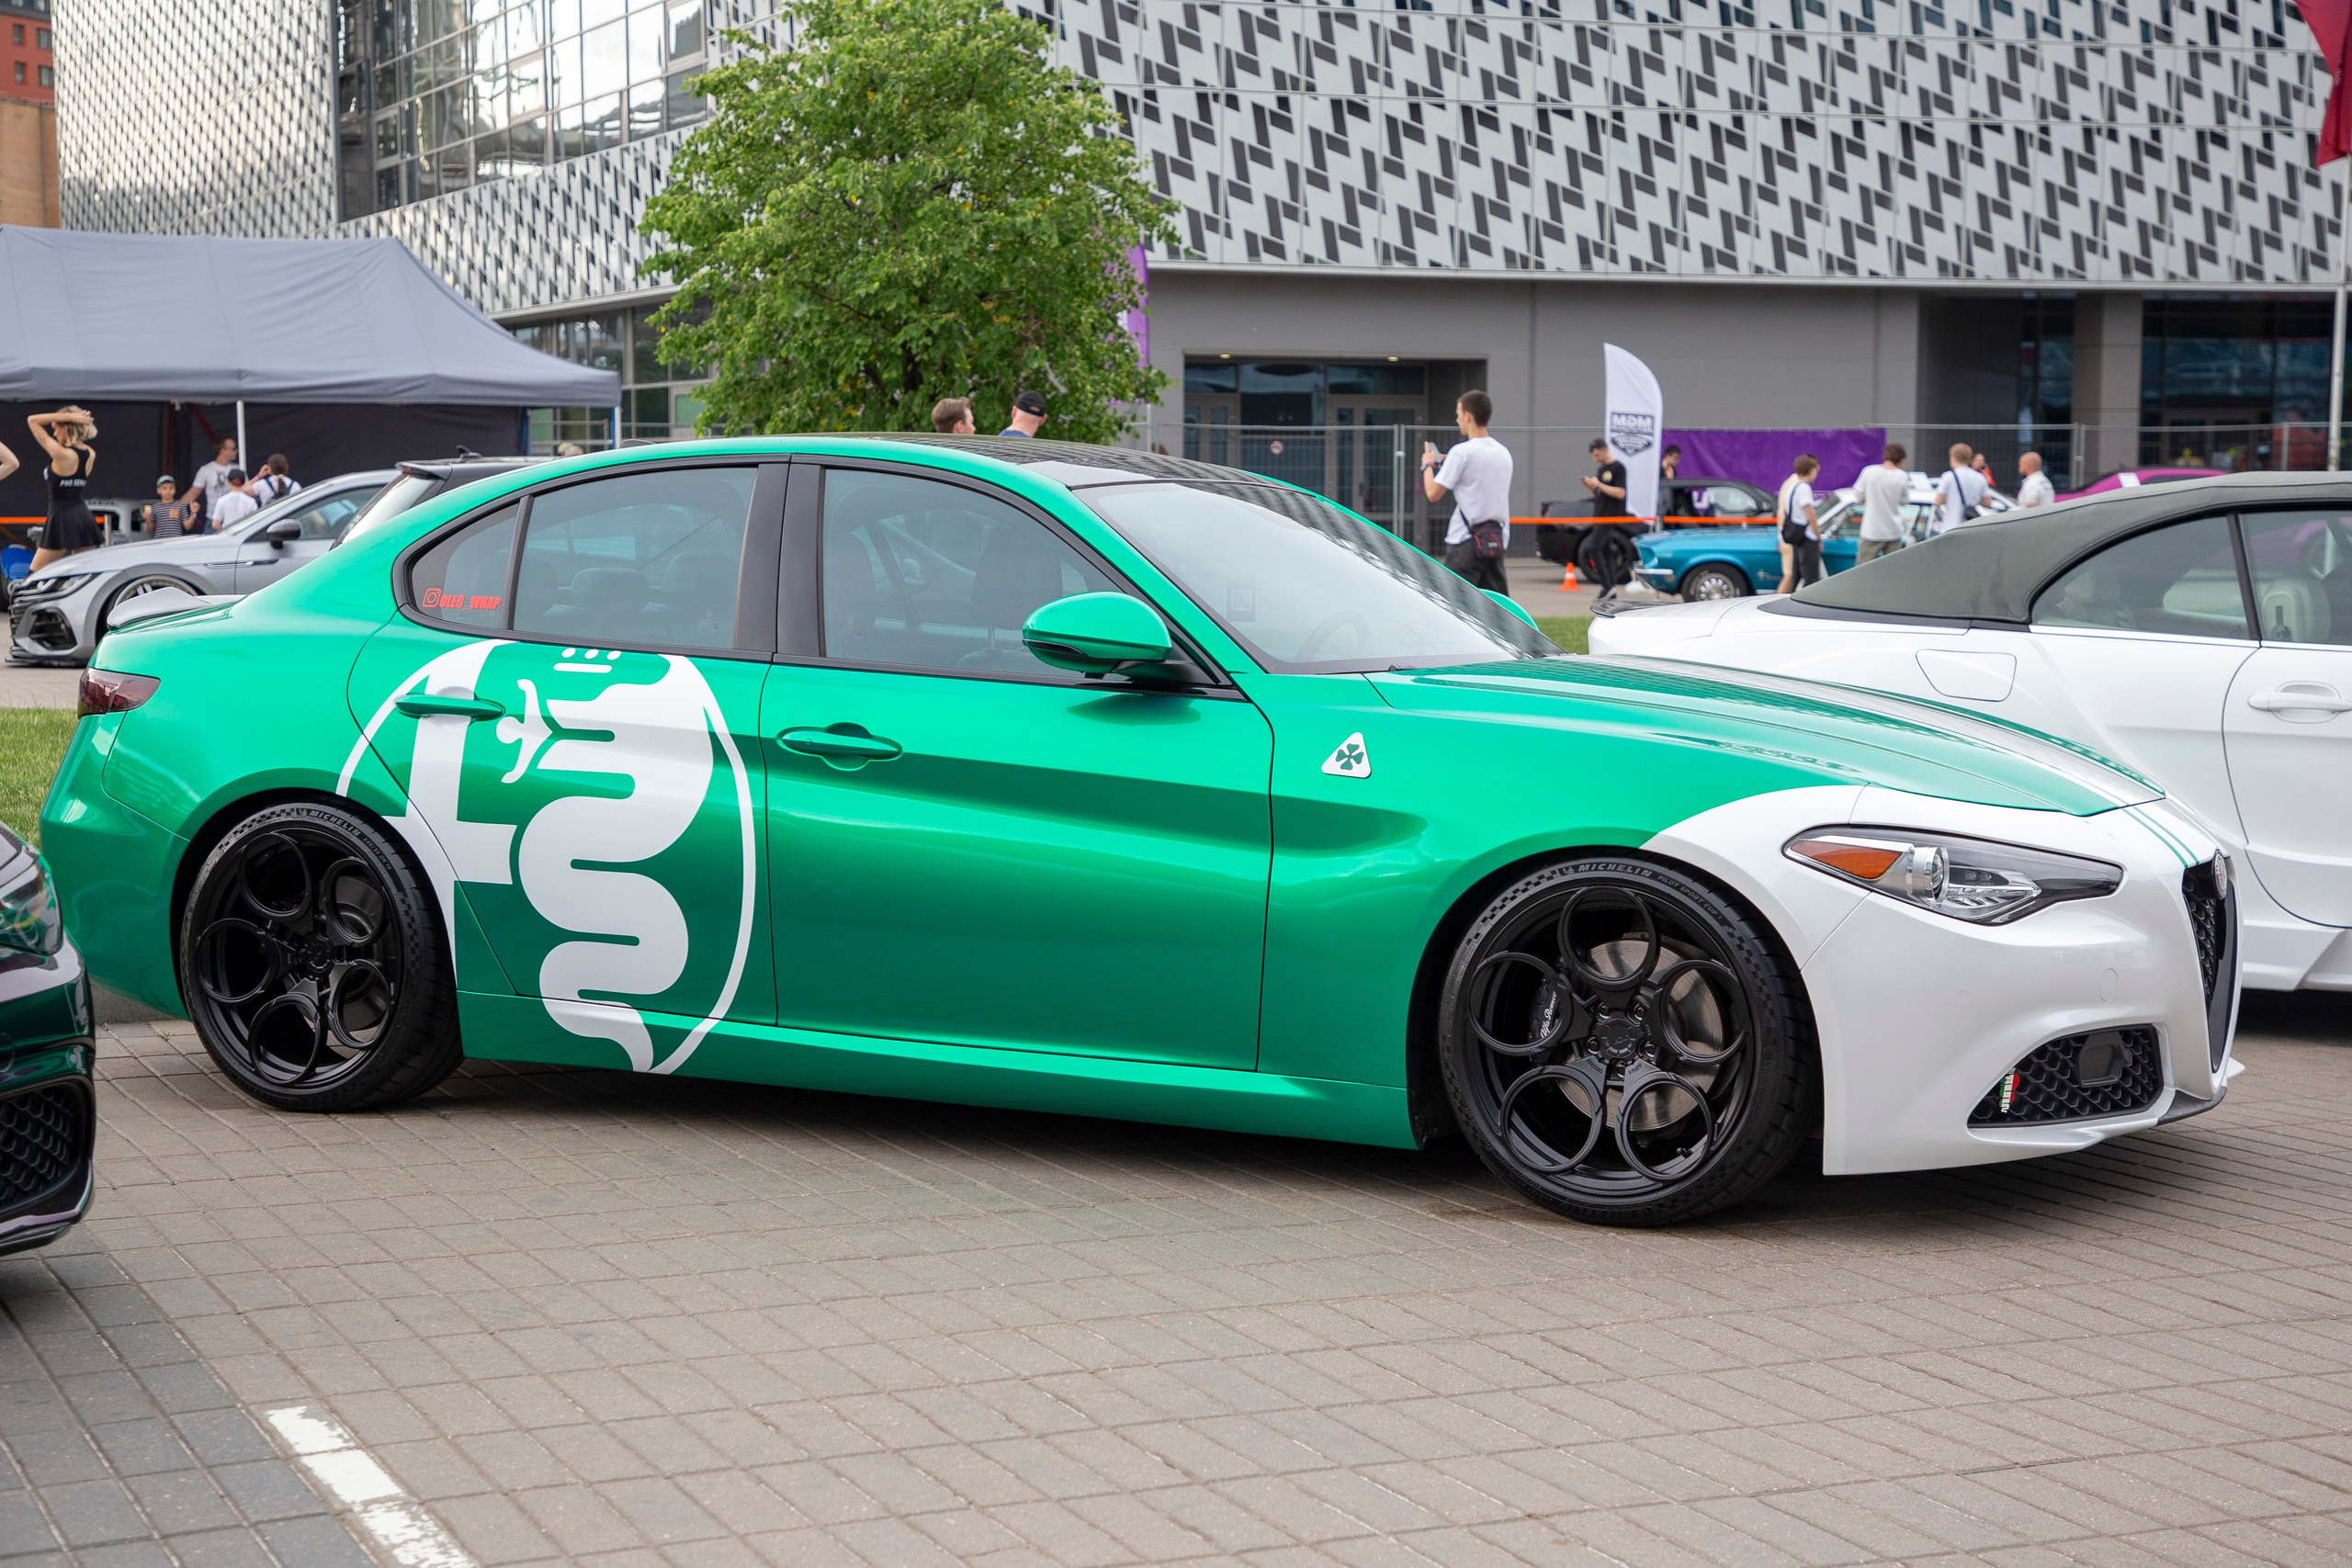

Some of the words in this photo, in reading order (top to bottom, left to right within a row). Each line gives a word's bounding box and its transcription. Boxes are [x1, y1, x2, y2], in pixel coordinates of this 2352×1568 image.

[439, 594, 502, 611] OLEG_WRAP
[310, 810, 361, 837] MICHELIN
[1577, 863, 1653, 877] MICHELIN
[1657, 875, 1679, 887] PILOT
[1679, 886, 1704, 903] SPORT
[1703, 903, 1719, 915] CUP
[1544, 990, 1557, 1021] Romeo
